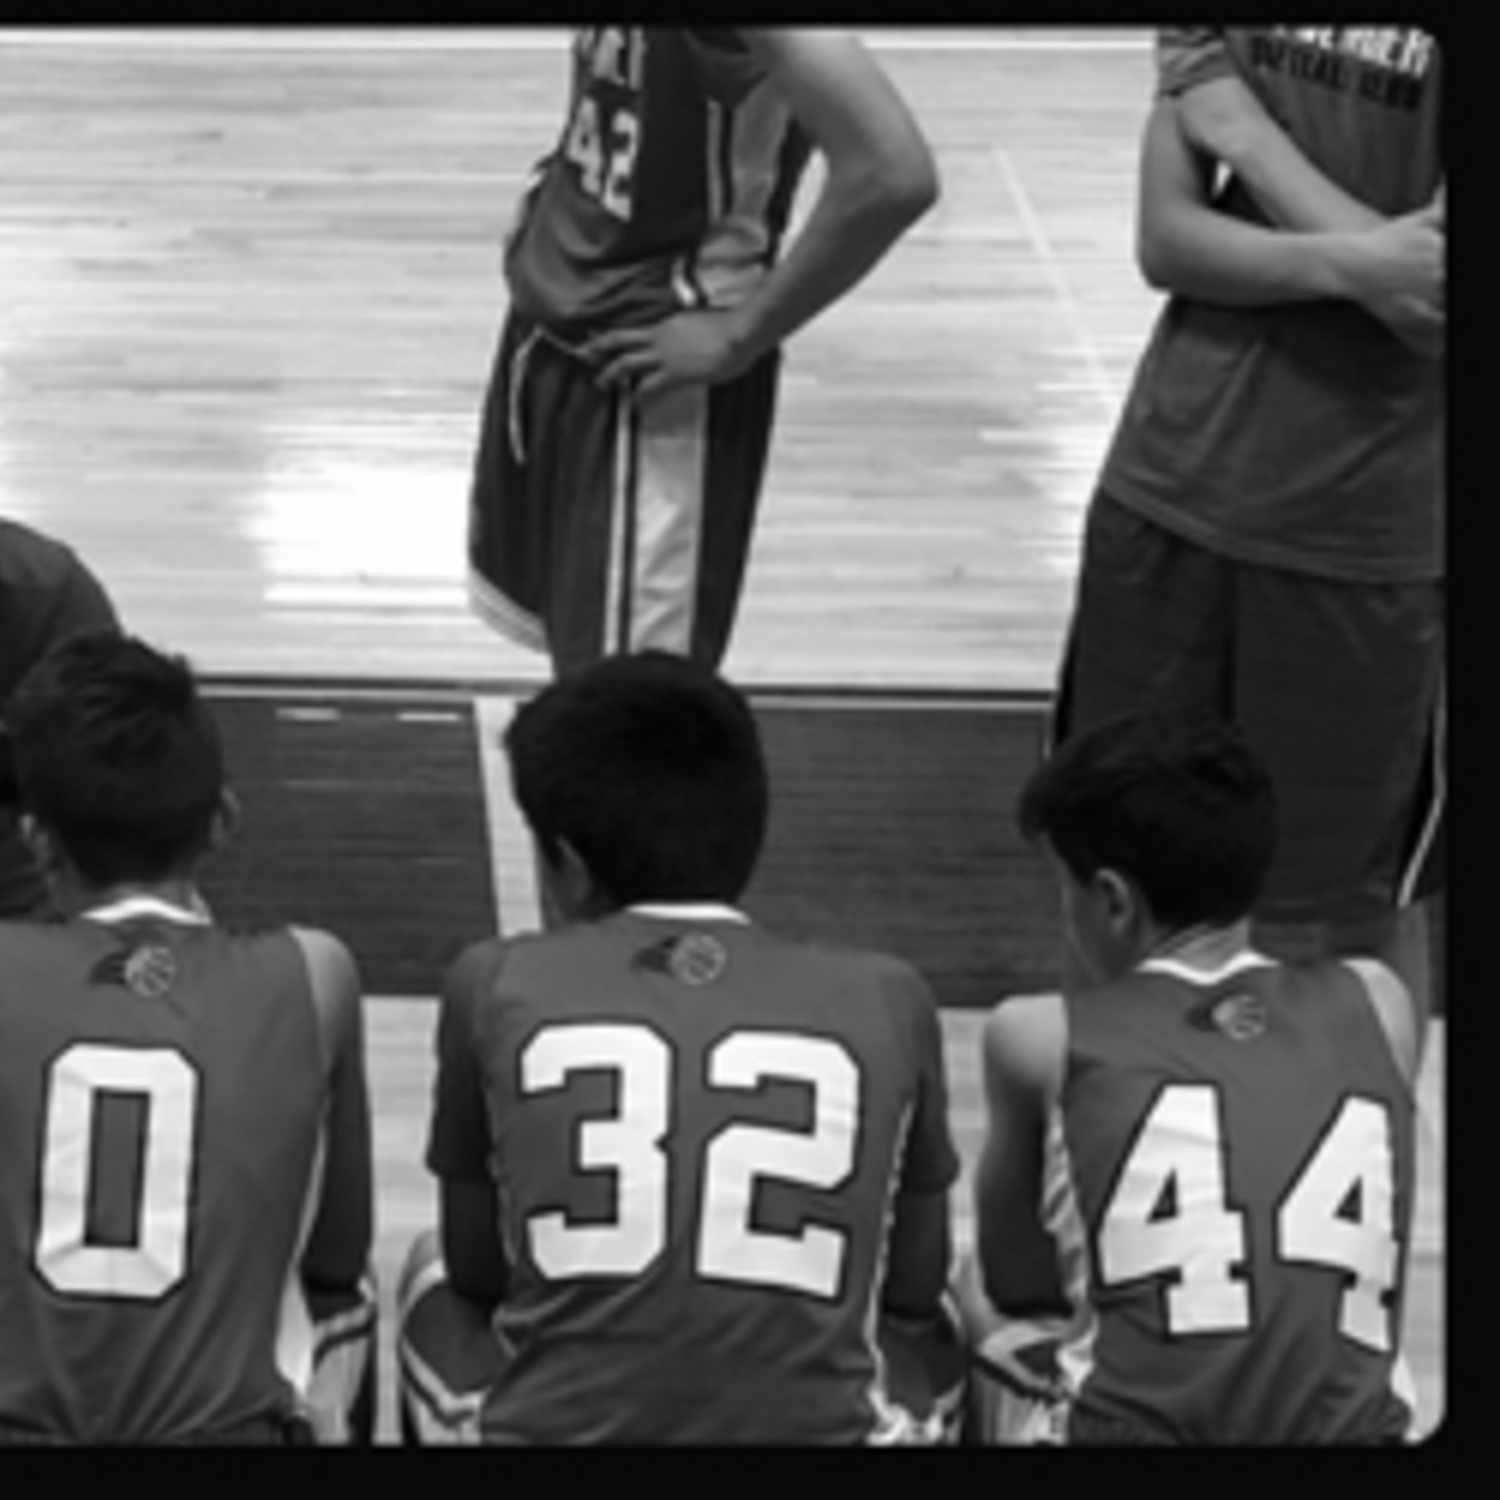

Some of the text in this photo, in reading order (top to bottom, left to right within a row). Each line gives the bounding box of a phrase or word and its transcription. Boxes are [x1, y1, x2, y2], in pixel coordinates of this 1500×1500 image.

[565, 98, 639, 223] 42
[34, 1040, 200, 1302] 0
[518, 1022, 862, 1300] 32
[1100, 1083, 1399, 1353] 44
